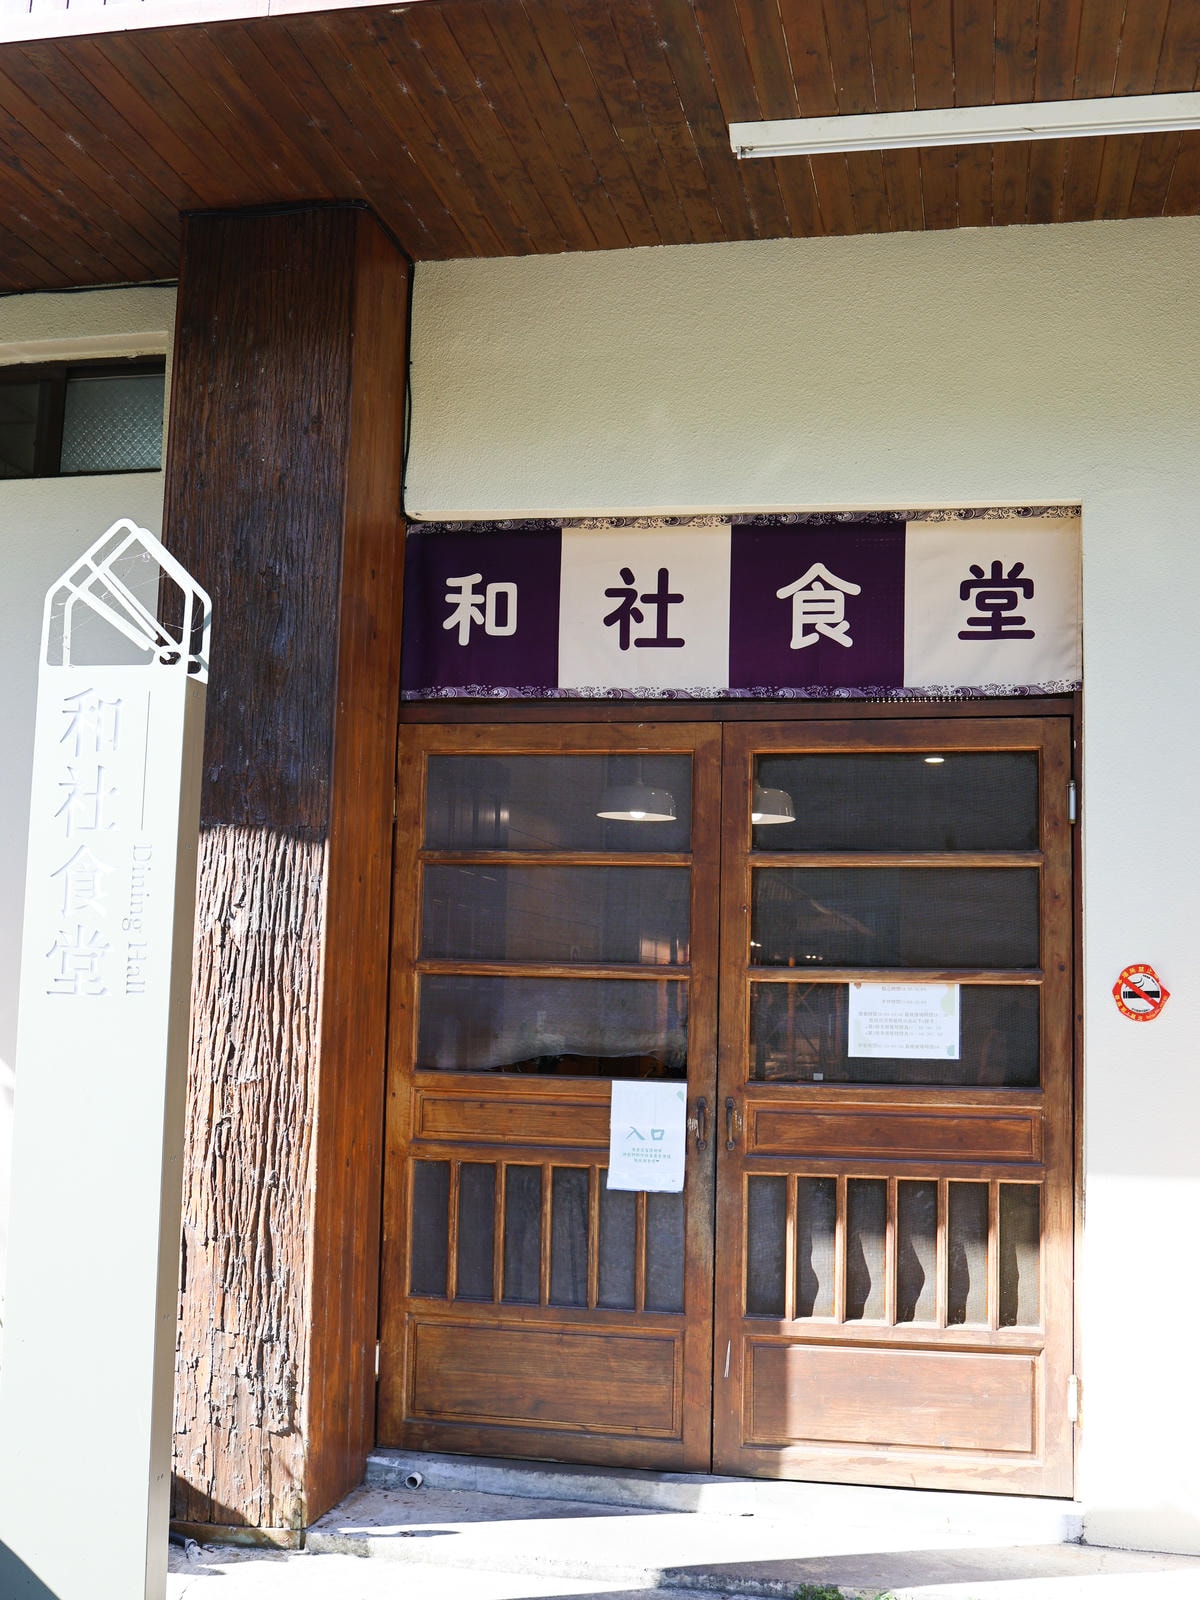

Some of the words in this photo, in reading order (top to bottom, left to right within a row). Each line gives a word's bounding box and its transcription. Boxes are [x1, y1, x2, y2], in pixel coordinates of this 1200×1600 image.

[442, 559, 1035, 652] 和社食堂
[46, 687, 122, 997] 和社食堂
[121, 842, 152, 933] Dining
[125, 940, 148, 995] Hall
[625, 1126, 665, 1141] 入口
